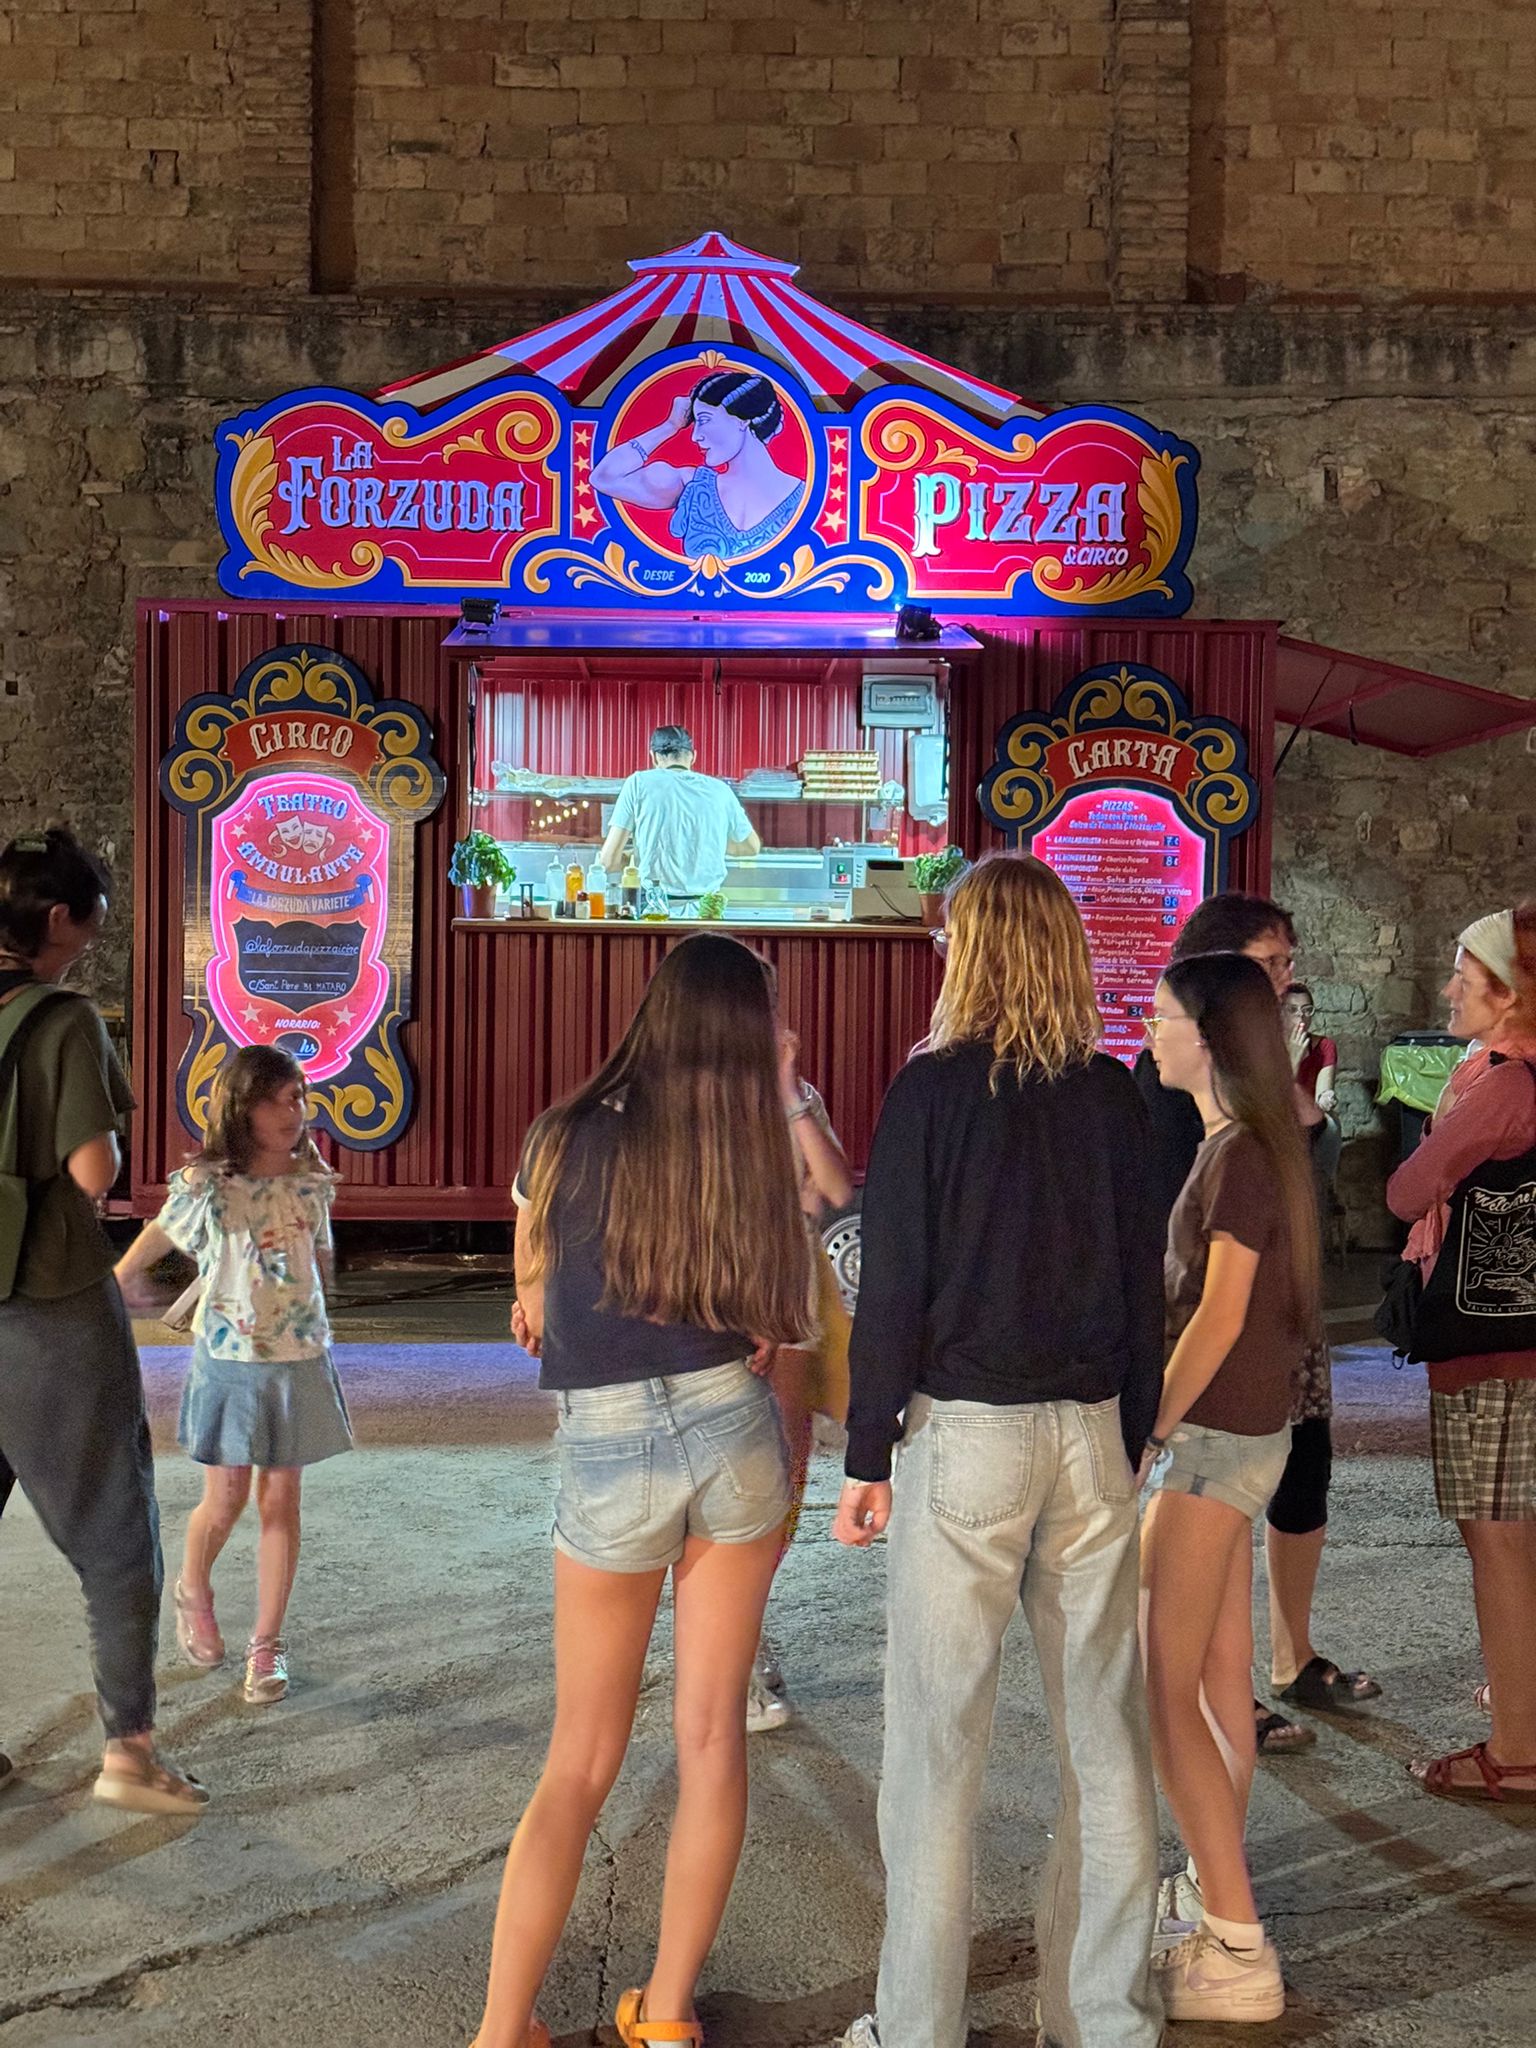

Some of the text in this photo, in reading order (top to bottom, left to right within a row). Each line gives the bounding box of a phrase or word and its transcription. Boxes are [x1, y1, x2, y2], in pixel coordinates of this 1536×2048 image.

[331, 435, 373, 472] LA
[277, 454, 526, 536] FORZUDA
[911, 472, 1128, 559] PIZZA
[1062, 545, 1130, 567] &CIRCO
[642, 569, 676, 582] DESDE
[743, 572, 771, 584] 2020
[249, 720, 354, 760] CIRCO
[1066, 738, 1182, 781] CARTA
[257, 792, 348, 821] TEATRO
[236, 842, 365, 886] AMBULANTE
[266, 893, 310, 913] FORZUDA
[281, 979, 299, 990] Pere
[274, 1018, 321, 1030] HORARIO:
